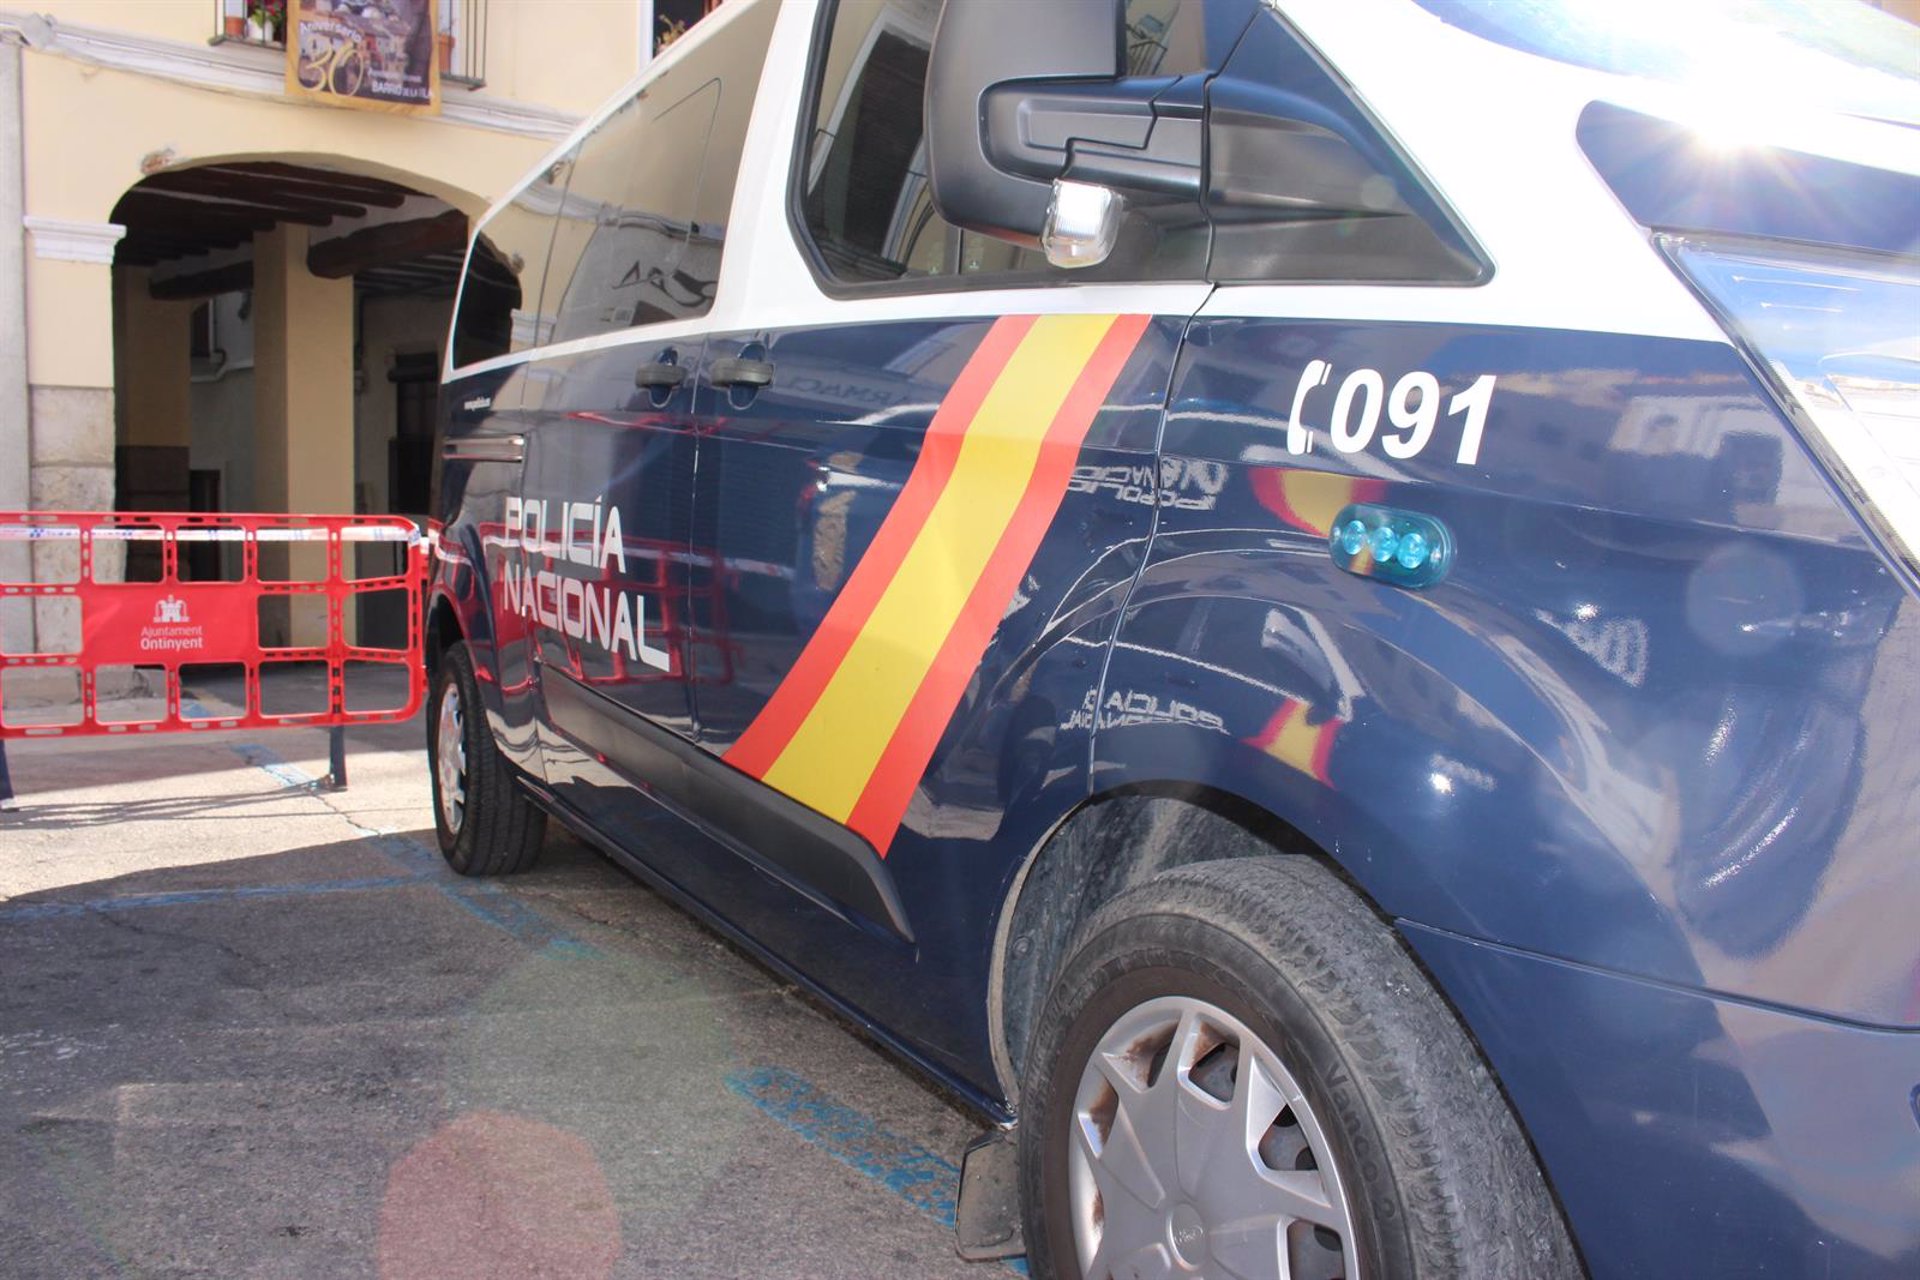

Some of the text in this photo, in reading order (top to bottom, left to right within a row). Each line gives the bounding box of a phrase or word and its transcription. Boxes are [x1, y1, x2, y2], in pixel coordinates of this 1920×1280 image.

[297, 36, 364, 97] 30
[1330, 368, 1497, 465] 091
[504, 495, 627, 574] POLICÍA
[140, 625, 203, 638] Ajuntament
[140, 637, 203, 651] Ontinyent
[503, 560, 671, 673] NACIONAL
[1324, 1061, 1378, 1183] Vanco
